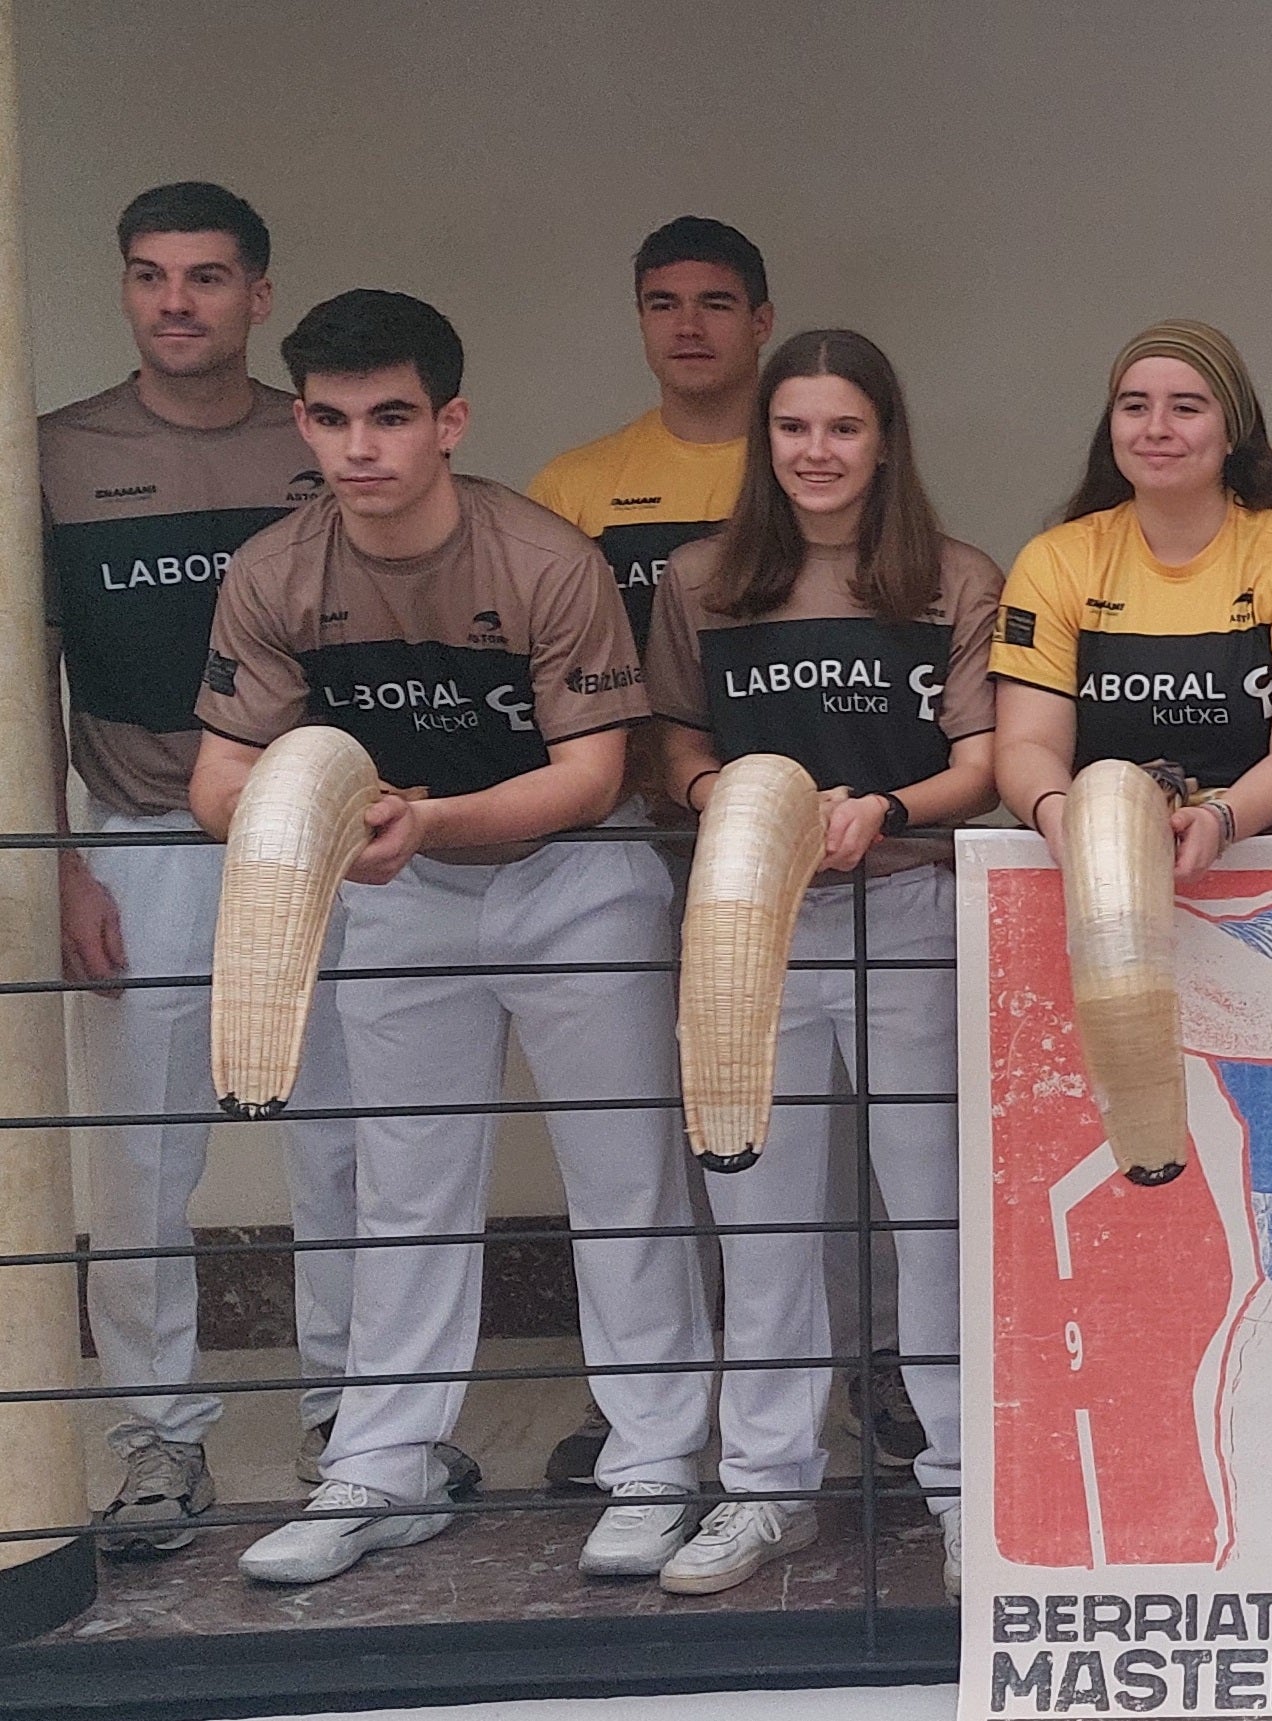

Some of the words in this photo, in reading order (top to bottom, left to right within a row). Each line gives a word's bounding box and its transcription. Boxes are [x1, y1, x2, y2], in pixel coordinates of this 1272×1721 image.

[725, 659, 892, 698] LABORAL
[822, 693, 889, 713] kutxa
[1152, 704, 1229, 725] kutxa
[1064, 1321, 1084, 1371] 9
